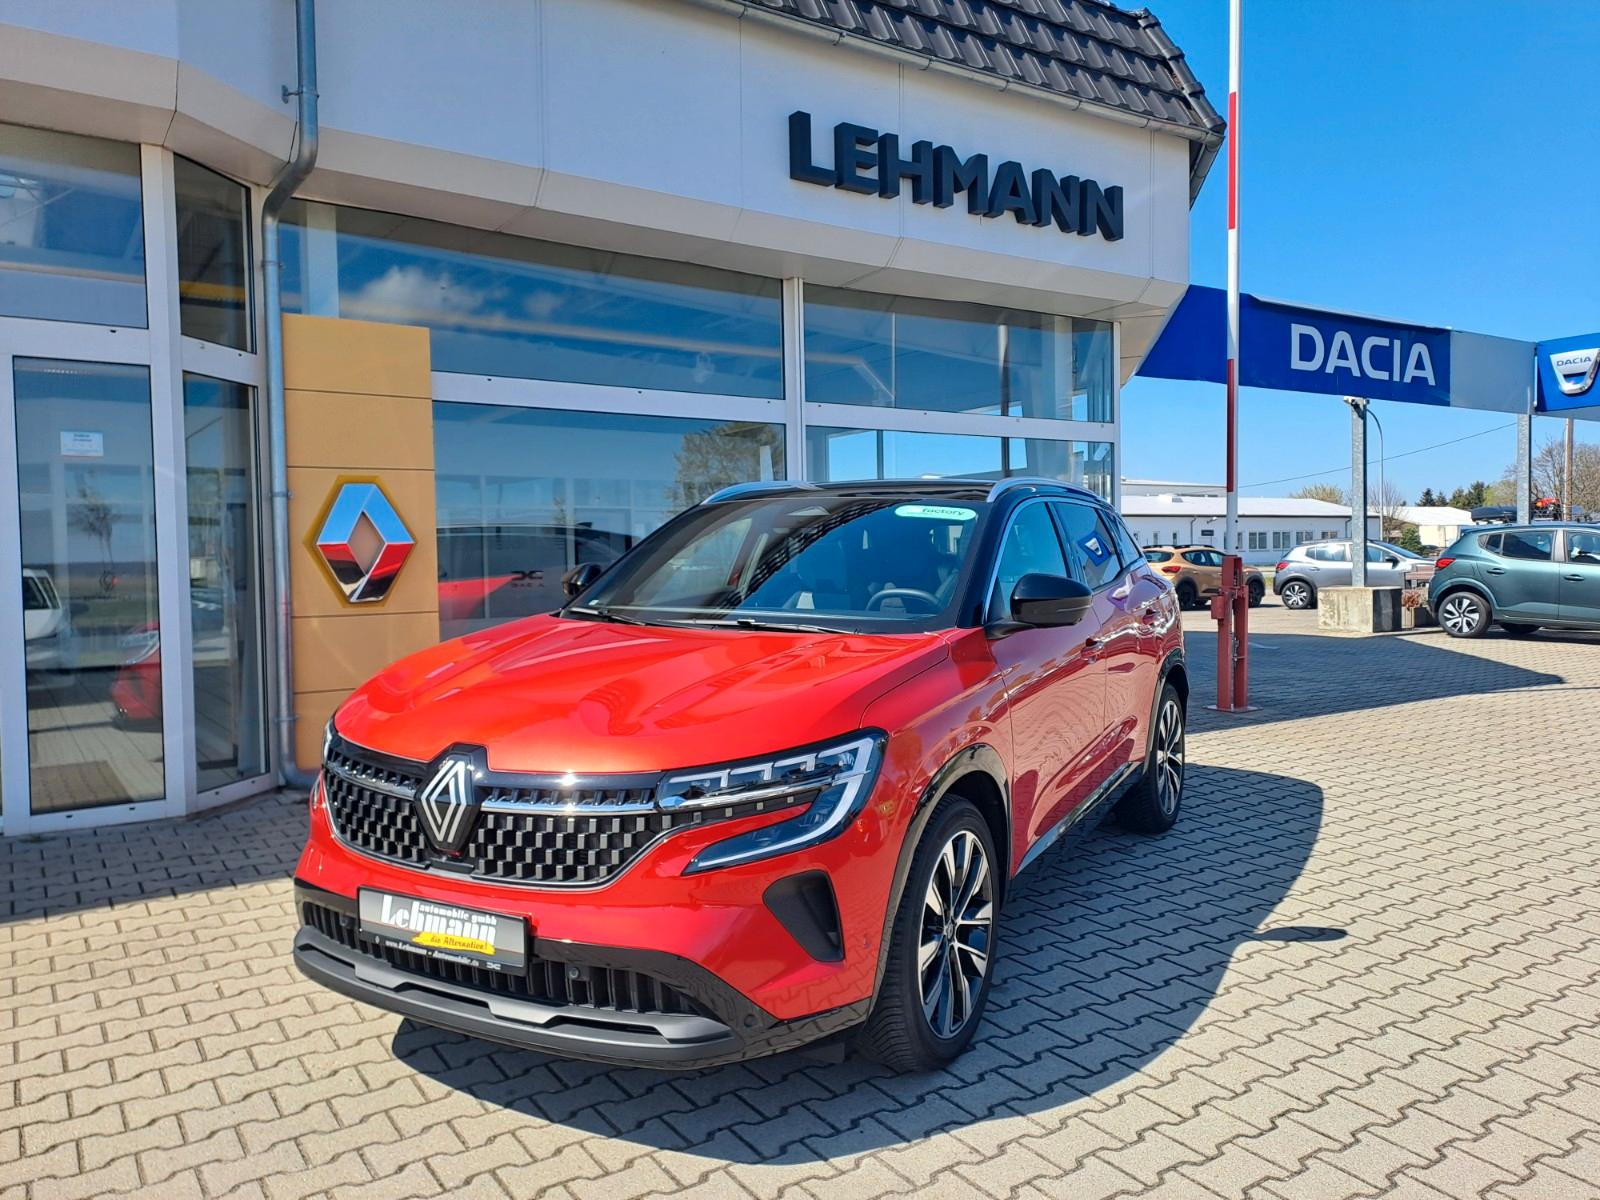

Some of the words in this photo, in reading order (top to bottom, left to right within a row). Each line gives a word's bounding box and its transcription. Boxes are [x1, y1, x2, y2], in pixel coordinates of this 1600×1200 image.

[788, 110, 1124, 241] LEHMANN
[1290, 323, 1436, 386] DACIA
[1556, 356, 1592, 367] DACIA
[381, 894, 497, 945] Lehmann
[419, 904, 470, 920] automobile
[471, 909, 497, 926] gmbh
